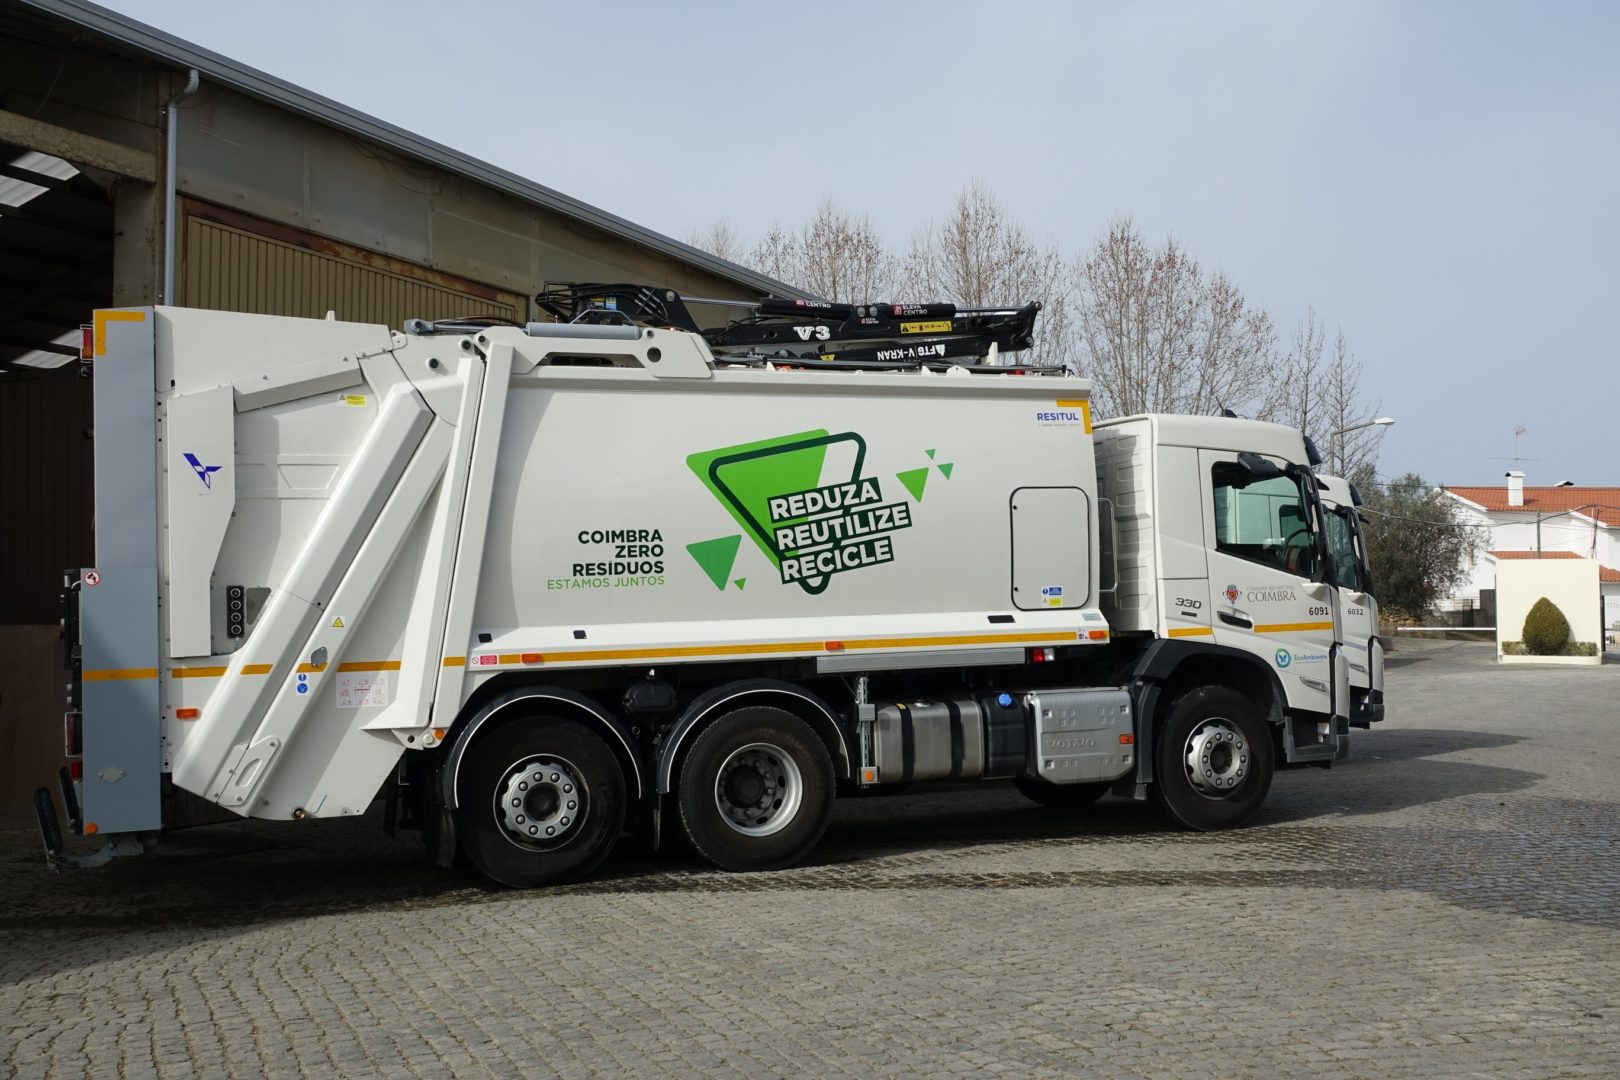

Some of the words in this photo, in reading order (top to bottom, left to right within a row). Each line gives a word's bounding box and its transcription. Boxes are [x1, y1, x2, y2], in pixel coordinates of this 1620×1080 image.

[793, 325, 831, 341] V3
[877, 348, 915, 361] V-KRAN
[1036, 412, 1079, 421] RESITUL
[770, 481, 880, 520] REDUZA
[776, 505, 909, 550] REUTILIZE
[578, 529, 664, 544] COIMBRA
[615, 544, 664, 558] ZERO
[781, 539, 892, 581] RECICLE
[572, 560, 665, 577] RESÍDUOS
[547, 577, 610, 590] ESTAMOS
[613, 575, 665, 588] JUNTOS
[1175, 597, 1202, 609] 330
[1247, 590, 1297, 603] COIMBRA
[1308, 606, 1329, 616] 6091
[1347, 608, 1364, 616] 6032
